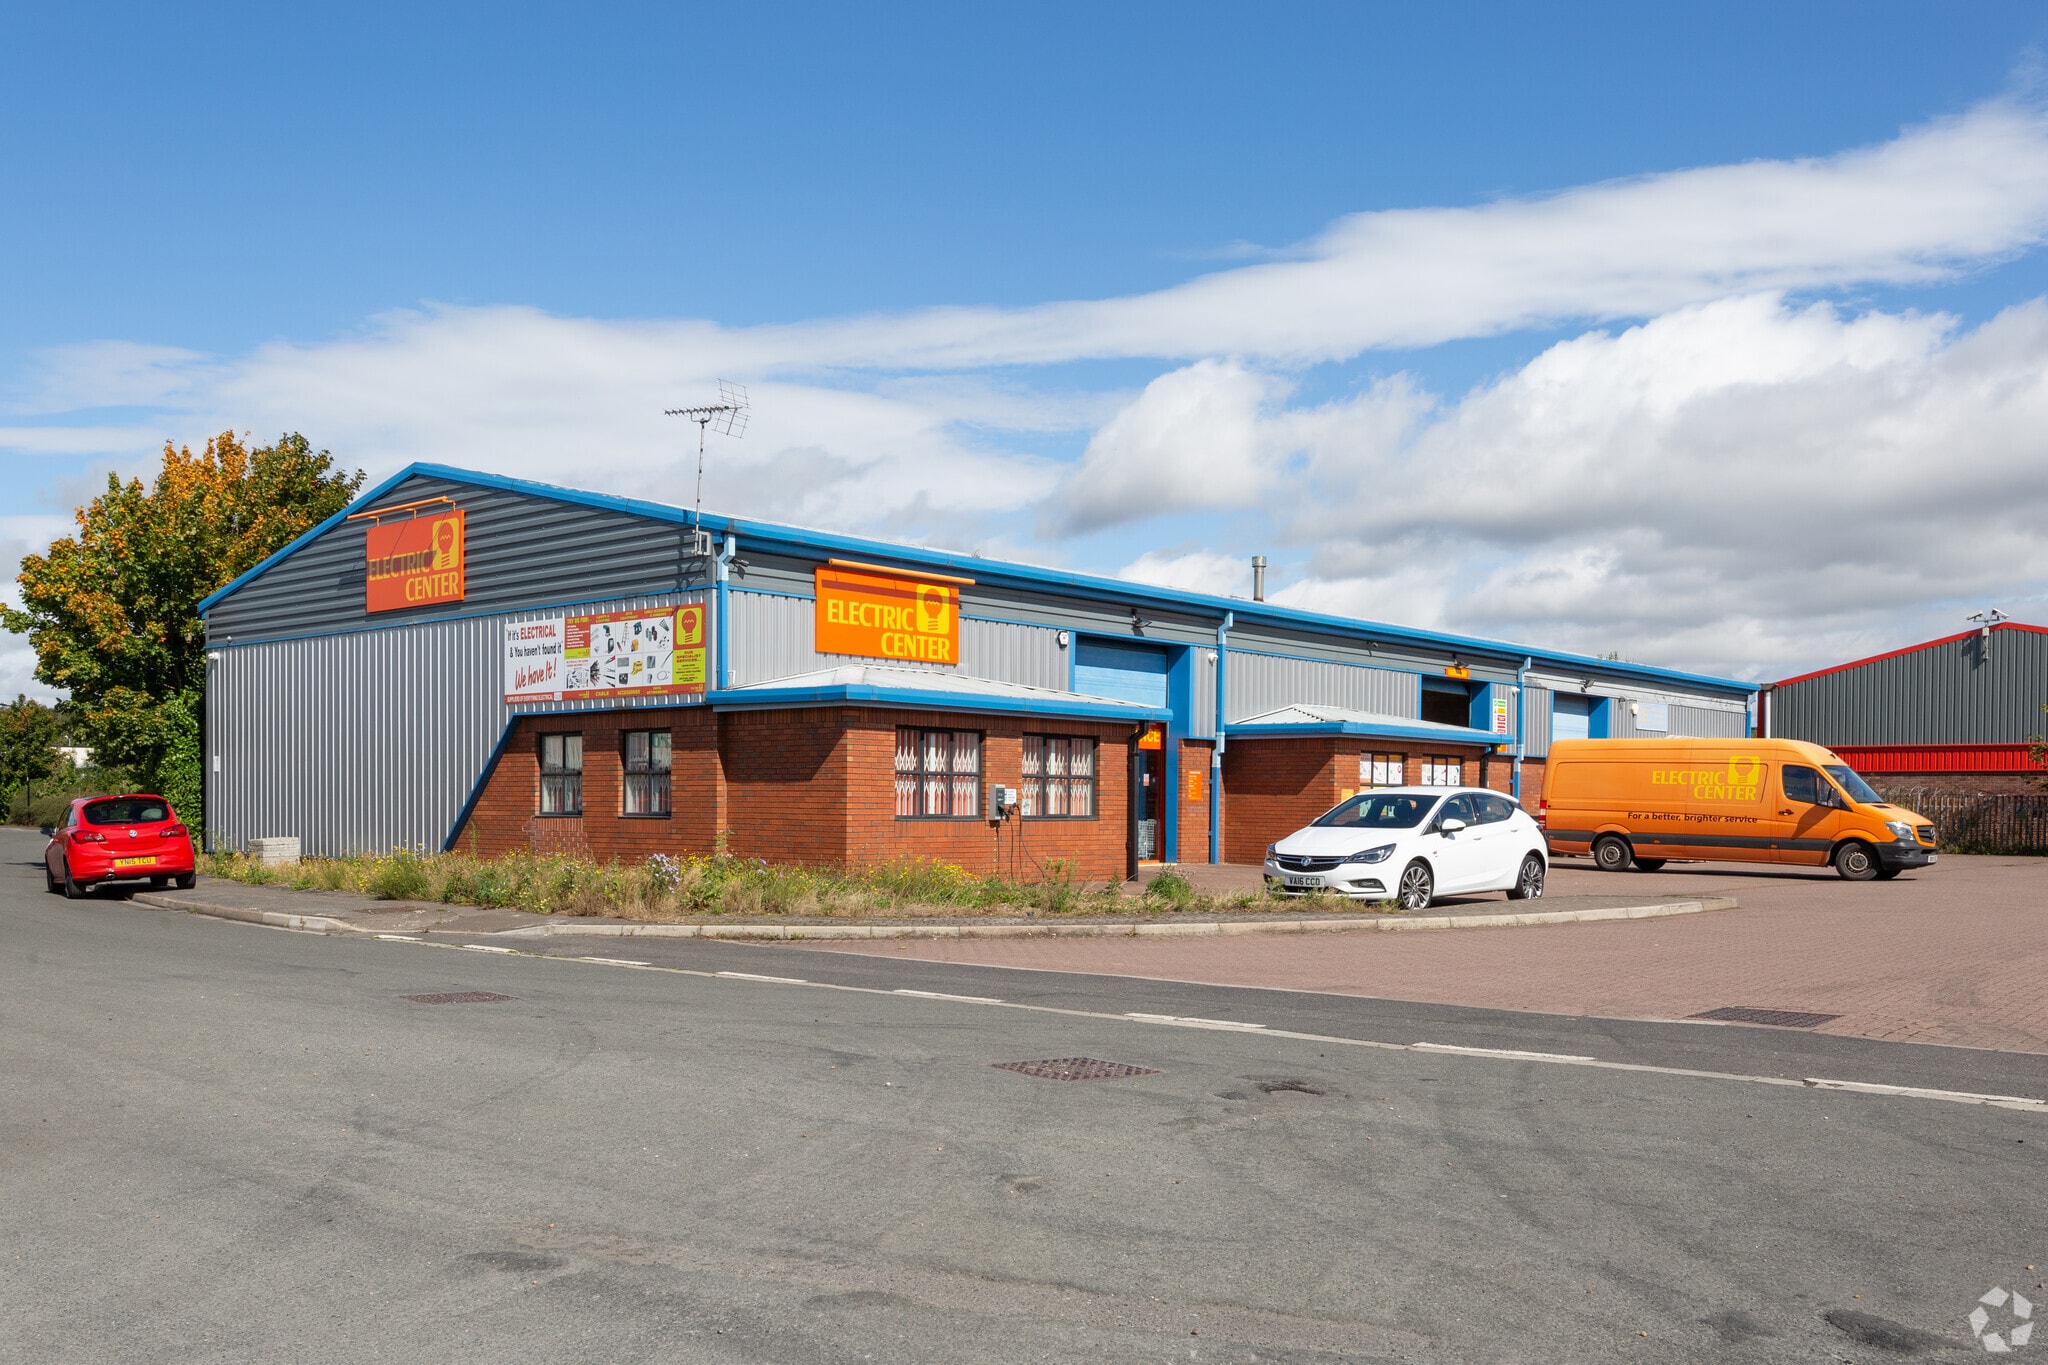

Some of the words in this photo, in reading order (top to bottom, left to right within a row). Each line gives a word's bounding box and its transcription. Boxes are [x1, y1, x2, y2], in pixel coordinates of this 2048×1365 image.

[368, 549, 430, 581] ELECTRIC
[405, 571, 459, 601] CENTER
[827, 598, 914, 631] ELECTRIC
[520, 624, 556, 640] ELECTRICAL
[510, 646, 513, 658] &
[514, 646, 523, 657] You
[524, 644, 541, 657] haven't
[542, 643, 557, 655] found
[881, 632, 950, 660] CENTER
[515, 666, 526, 690] We
[528, 665, 545, 686] have
[1652, 770, 1725, 785] ELECTRIC
[1693, 785, 1757, 800] CENTER
[1627, 812, 1642, 820] For
[1652, 812, 1681, 821] better,
[1684, 813, 1722, 823] brighter
[1724, 815, 1758, 824] service
[1289, 876, 1304, 886] VA16
